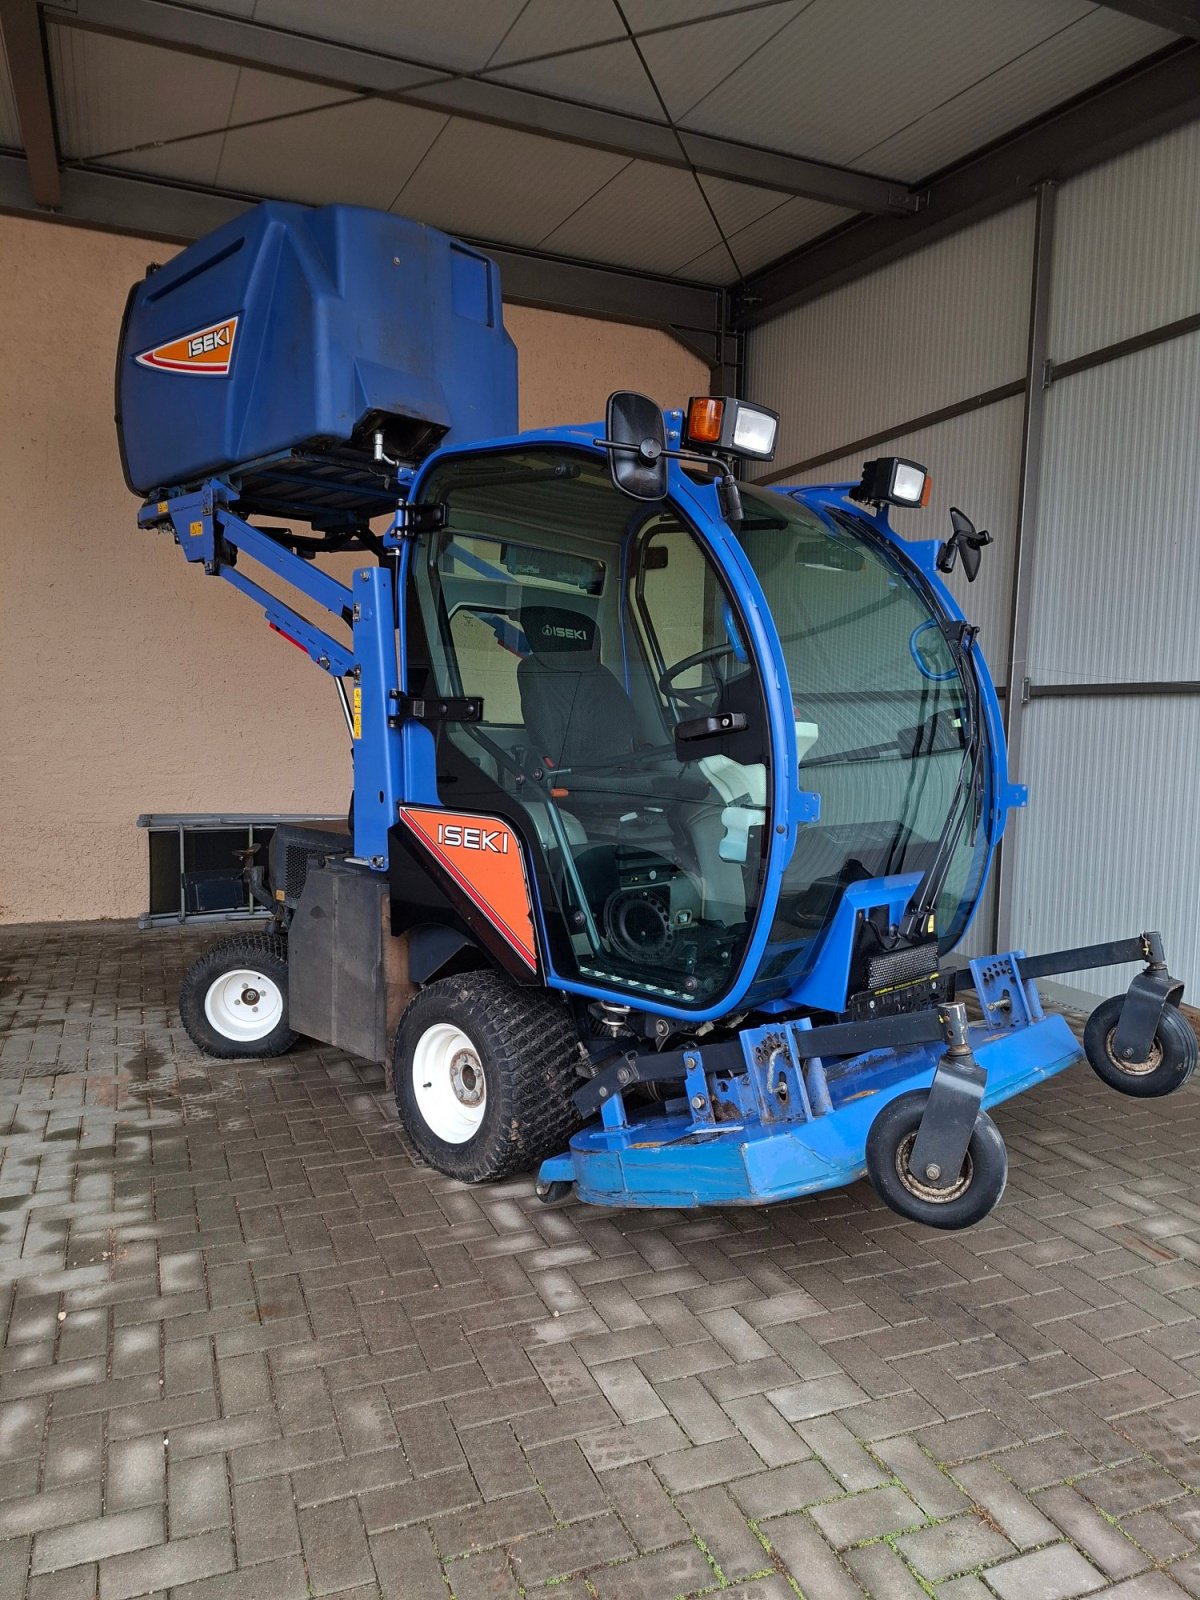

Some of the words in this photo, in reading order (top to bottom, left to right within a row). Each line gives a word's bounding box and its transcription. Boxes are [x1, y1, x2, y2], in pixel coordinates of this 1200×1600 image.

[188, 326, 230, 358] ISEKI
[552, 626, 587, 640] ISEKI
[438, 824, 508, 854] ISEKI
